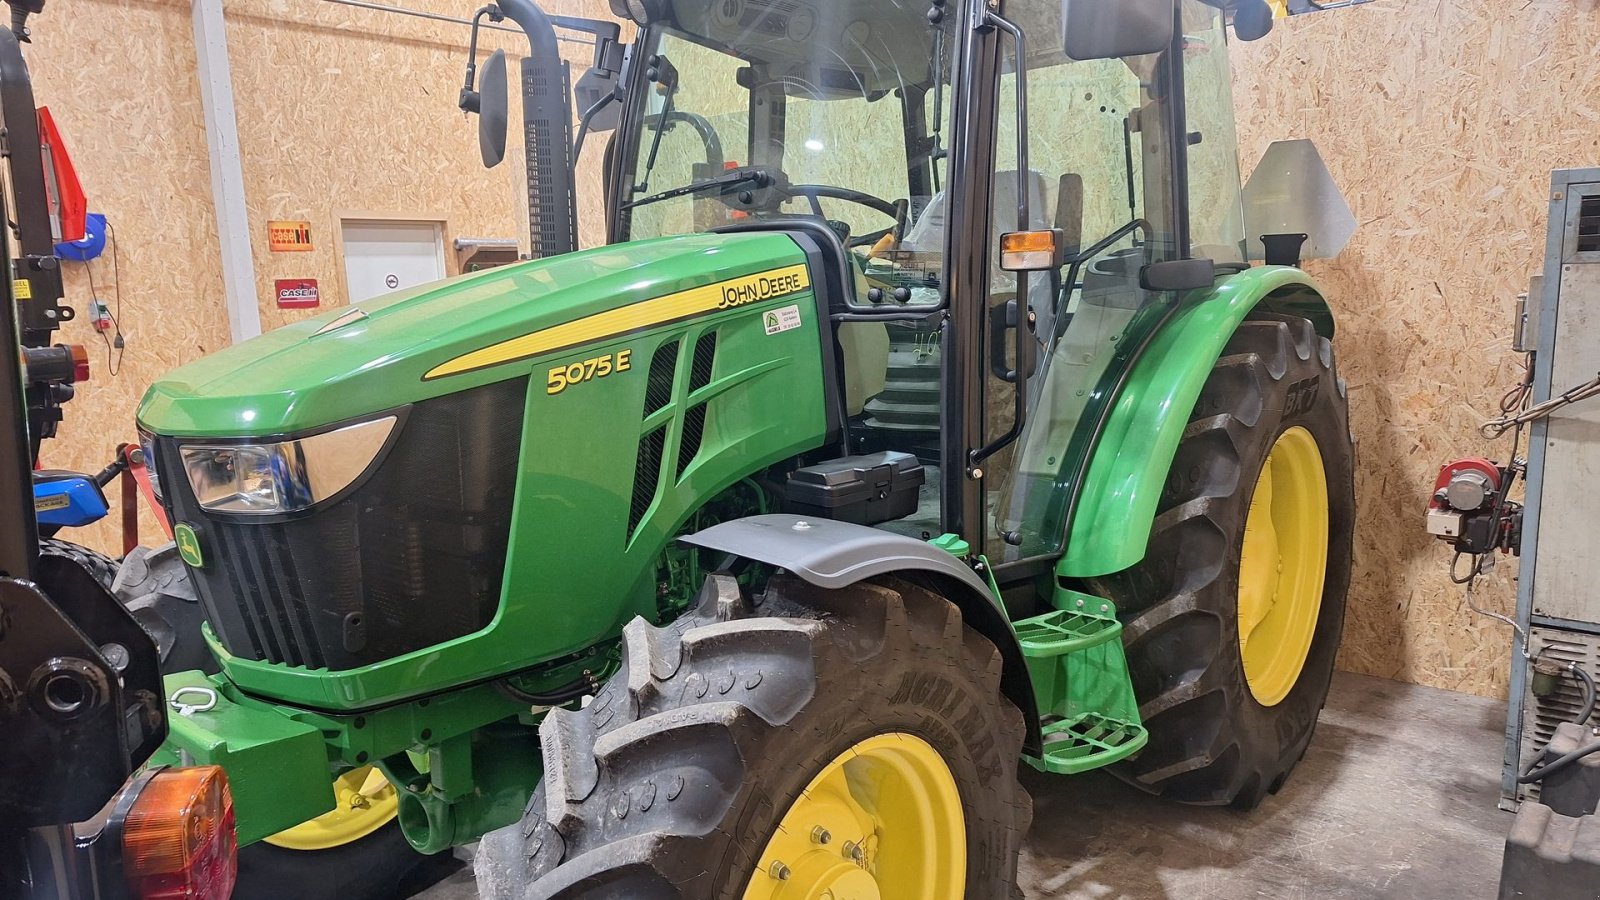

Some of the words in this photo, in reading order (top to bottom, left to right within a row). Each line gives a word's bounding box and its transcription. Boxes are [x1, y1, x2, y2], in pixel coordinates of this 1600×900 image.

[280, 289, 307, 297] CASE
[718, 282, 758, 306] JOHN
[758, 273, 801, 296] DEERE
[546, 353, 612, 395] 5075
[615, 349, 632, 372] E
